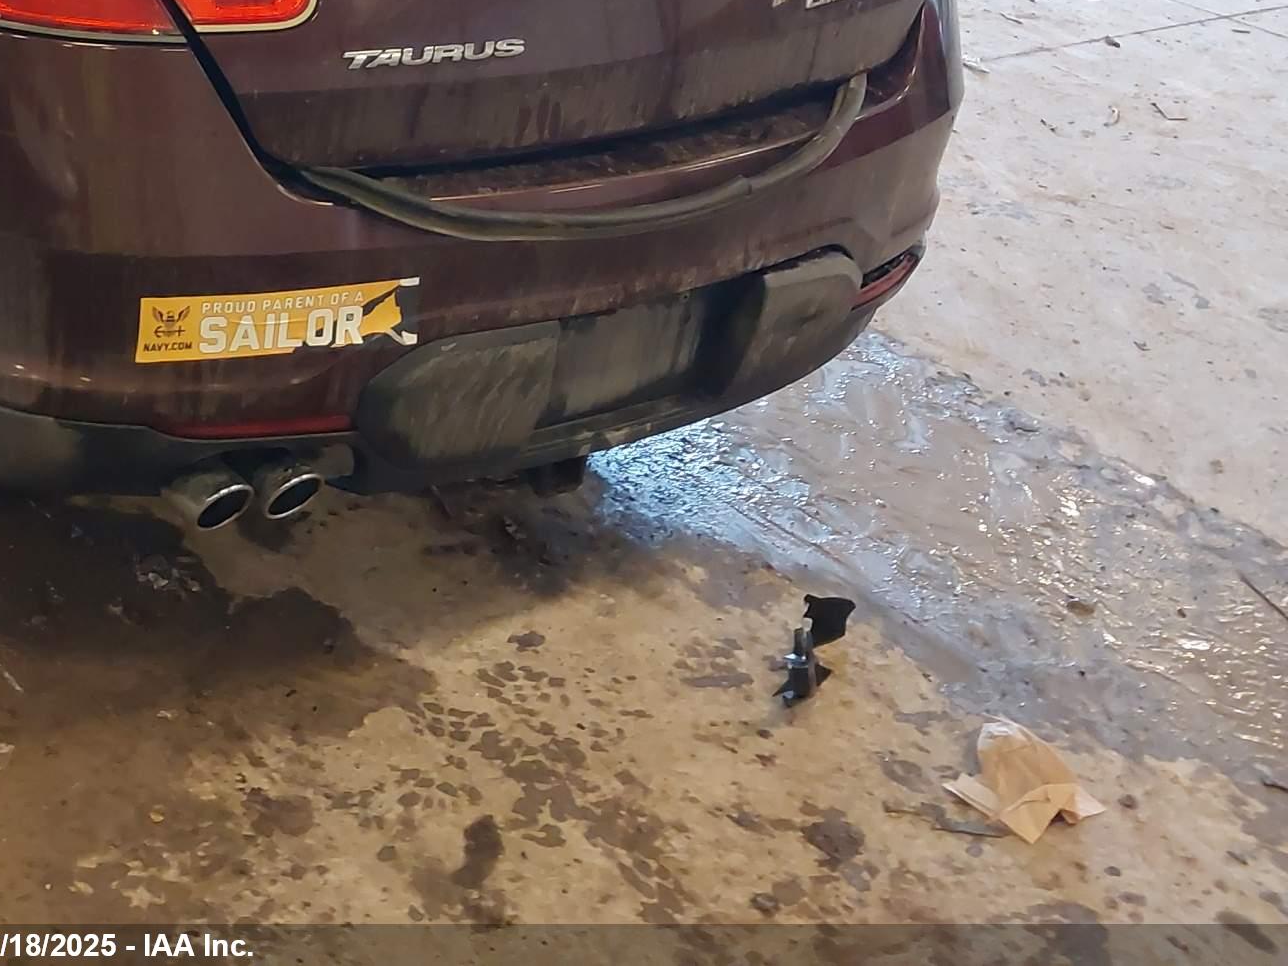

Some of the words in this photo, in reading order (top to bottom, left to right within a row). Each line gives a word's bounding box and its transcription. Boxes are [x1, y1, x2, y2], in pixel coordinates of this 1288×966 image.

[343, 38, 525, 70] TAURUS
[202, 300, 256, 314] PROUD
[262, 294, 325, 311] PARENT
[330, 291, 350, 305] OF
[354, 291, 365, 303] A
[199, 305, 364, 354] SAILOR
[143, 341, 192, 352] NAVY.COM
